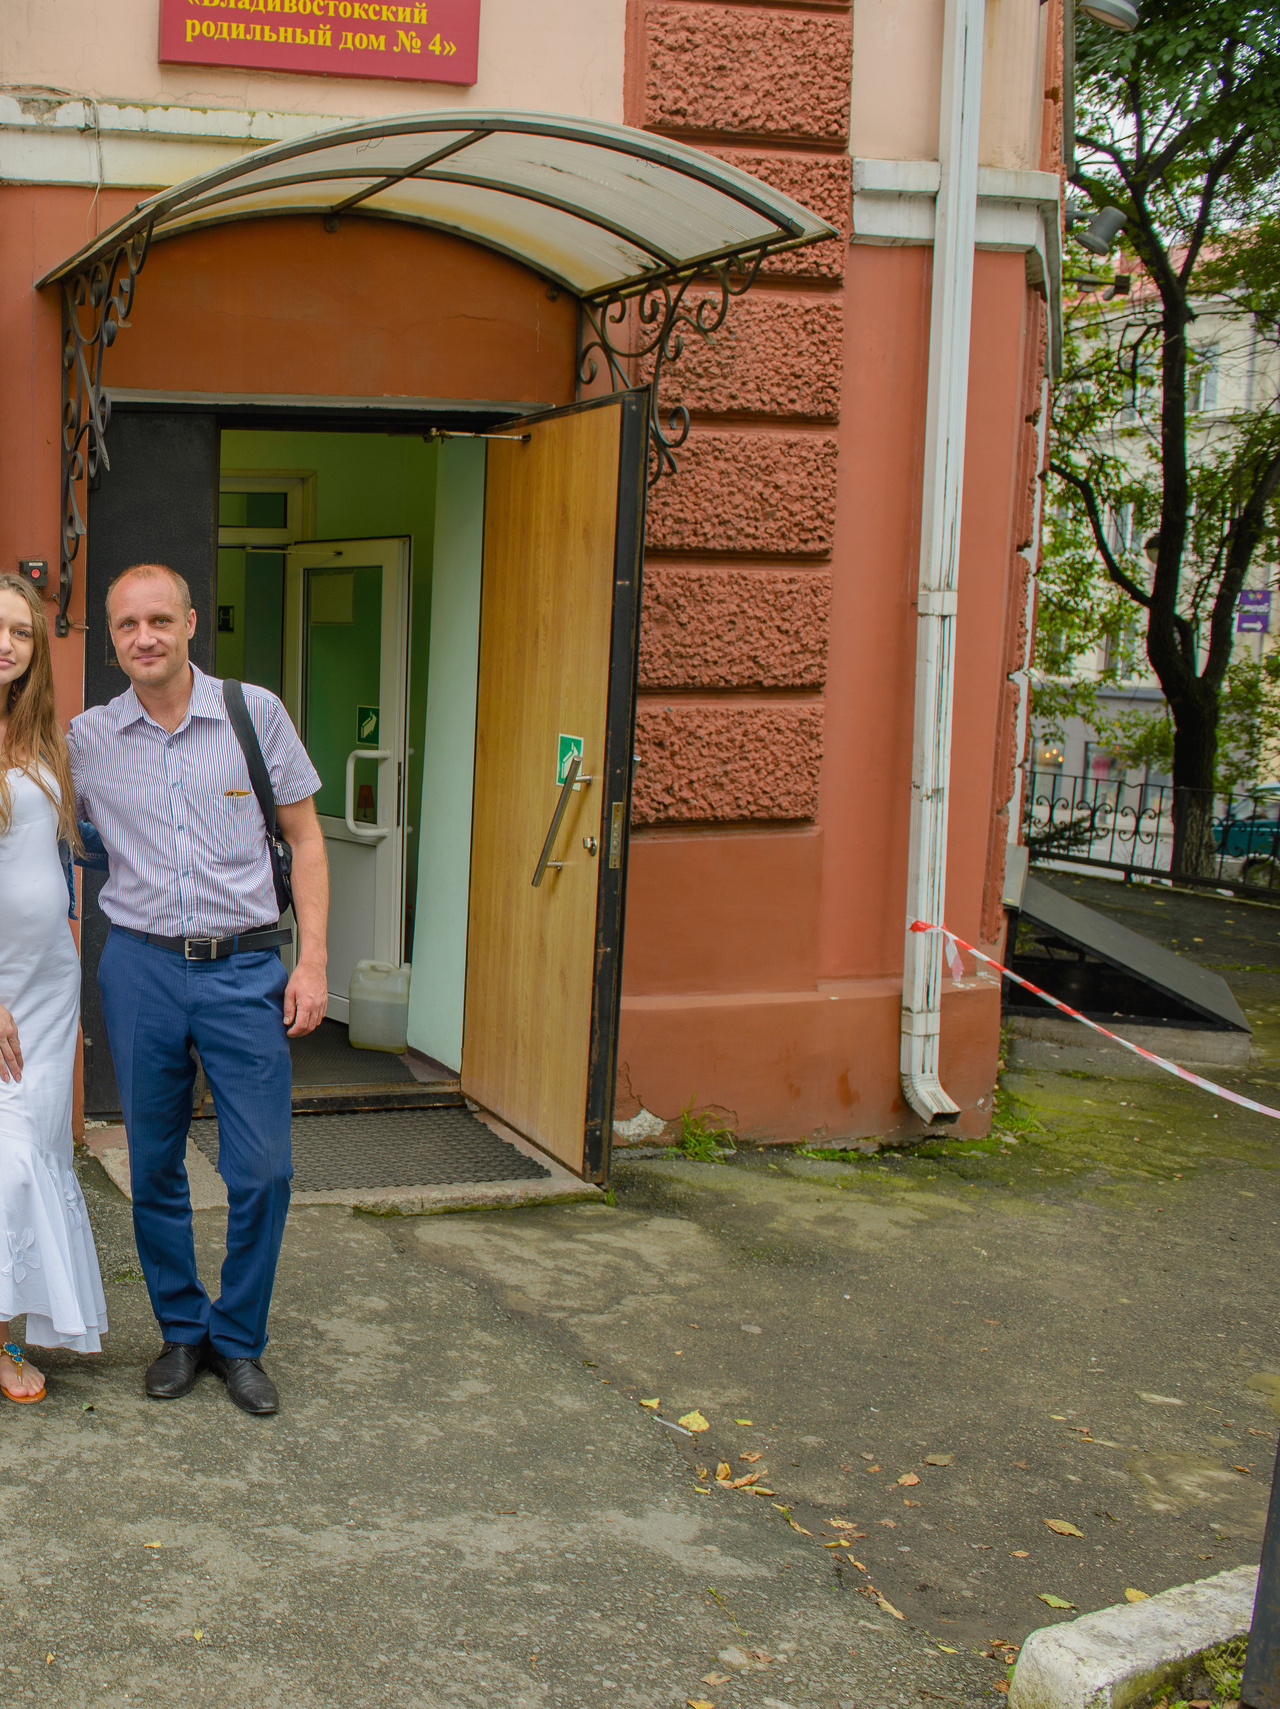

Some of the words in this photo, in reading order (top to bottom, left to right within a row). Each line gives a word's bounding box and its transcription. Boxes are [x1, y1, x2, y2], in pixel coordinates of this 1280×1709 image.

[185, 19, 333, 47] родильный
[338, 31, 387, 52] дом
[392, 29, 422, 54] №
[427, 32, 457, 57] 4»
